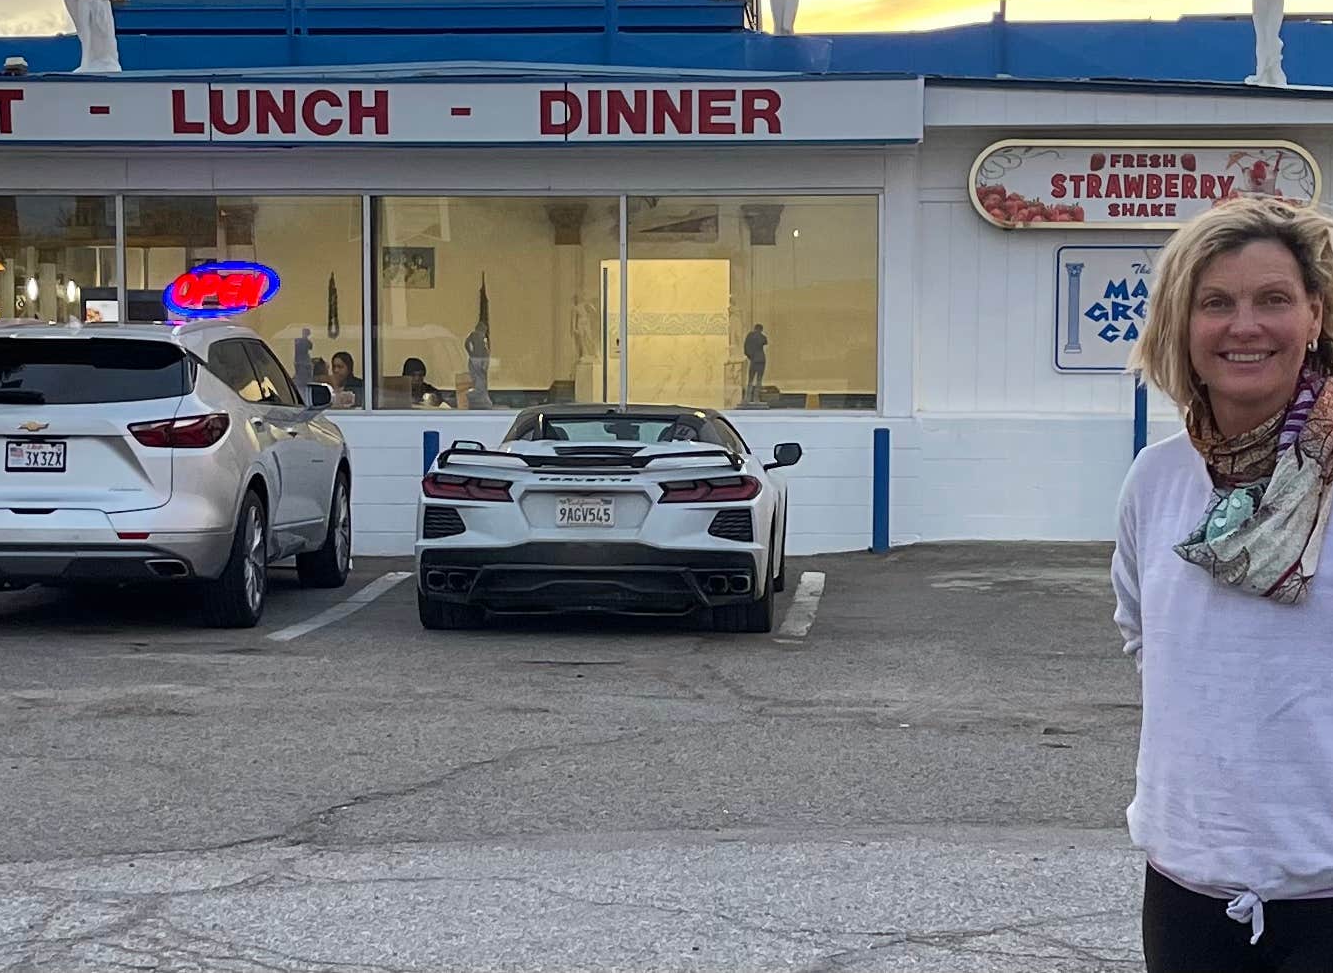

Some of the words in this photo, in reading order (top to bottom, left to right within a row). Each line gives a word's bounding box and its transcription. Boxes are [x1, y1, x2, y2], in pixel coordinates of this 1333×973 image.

[172, 89, 389, 136] LUNCH
[540, 89, 782, 136] DINNER
[1110, 153, 1177, 168] FRESH
[1050, 173, 1236, 199] STRAWBERRY
[1107, 203, 1177, 217] SHAKE
[171, 272, 268, 308] OPEN
[1104, 278, 1149, 301] MA
[1098, 322, 1140, 344] CA
[559, 507, 611, 523] 9AGV545
